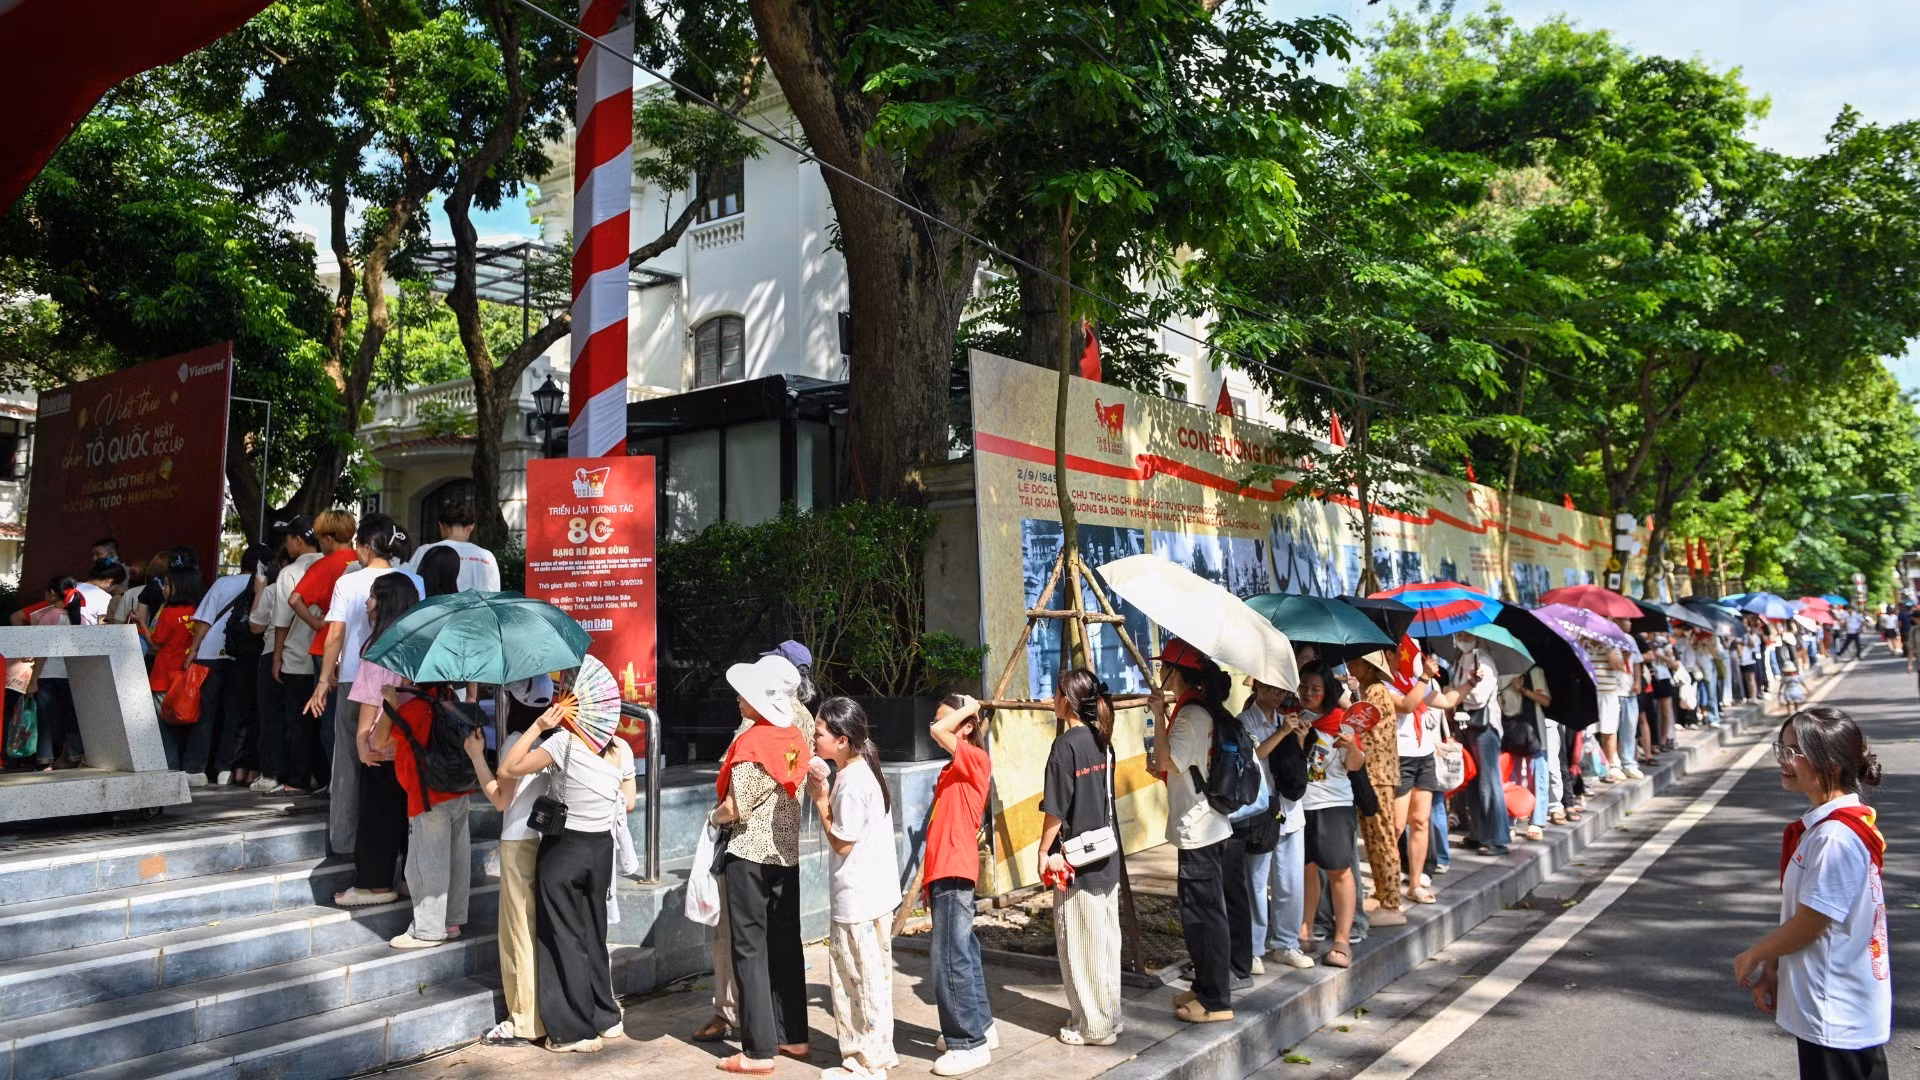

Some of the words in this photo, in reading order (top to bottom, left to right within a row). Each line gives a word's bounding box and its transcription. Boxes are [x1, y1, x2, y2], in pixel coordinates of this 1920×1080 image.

[188, 361, 225, 377] Vietravel
[95, 387, 136, 426] Viết
[154, 422, 175, 439] NGÀY
[86, 427, 104, 468] TỔ
[108, 423, 150, 464] QUỐC
[1177, 426, 1210, 453] CON
[111, 495, 123, 507] DO
[548, 504, 570, 515] TRIỂN
[591, 504, 617, 514] TƯƠNG
[619, 503, 634, 513] TÁC
[552, 548, 574, 558] RẠNG
[589, 547, 606, 556] NON
[608, 544, 629, 554] SÔNG
[582, 580, 598, 588] 17h00
